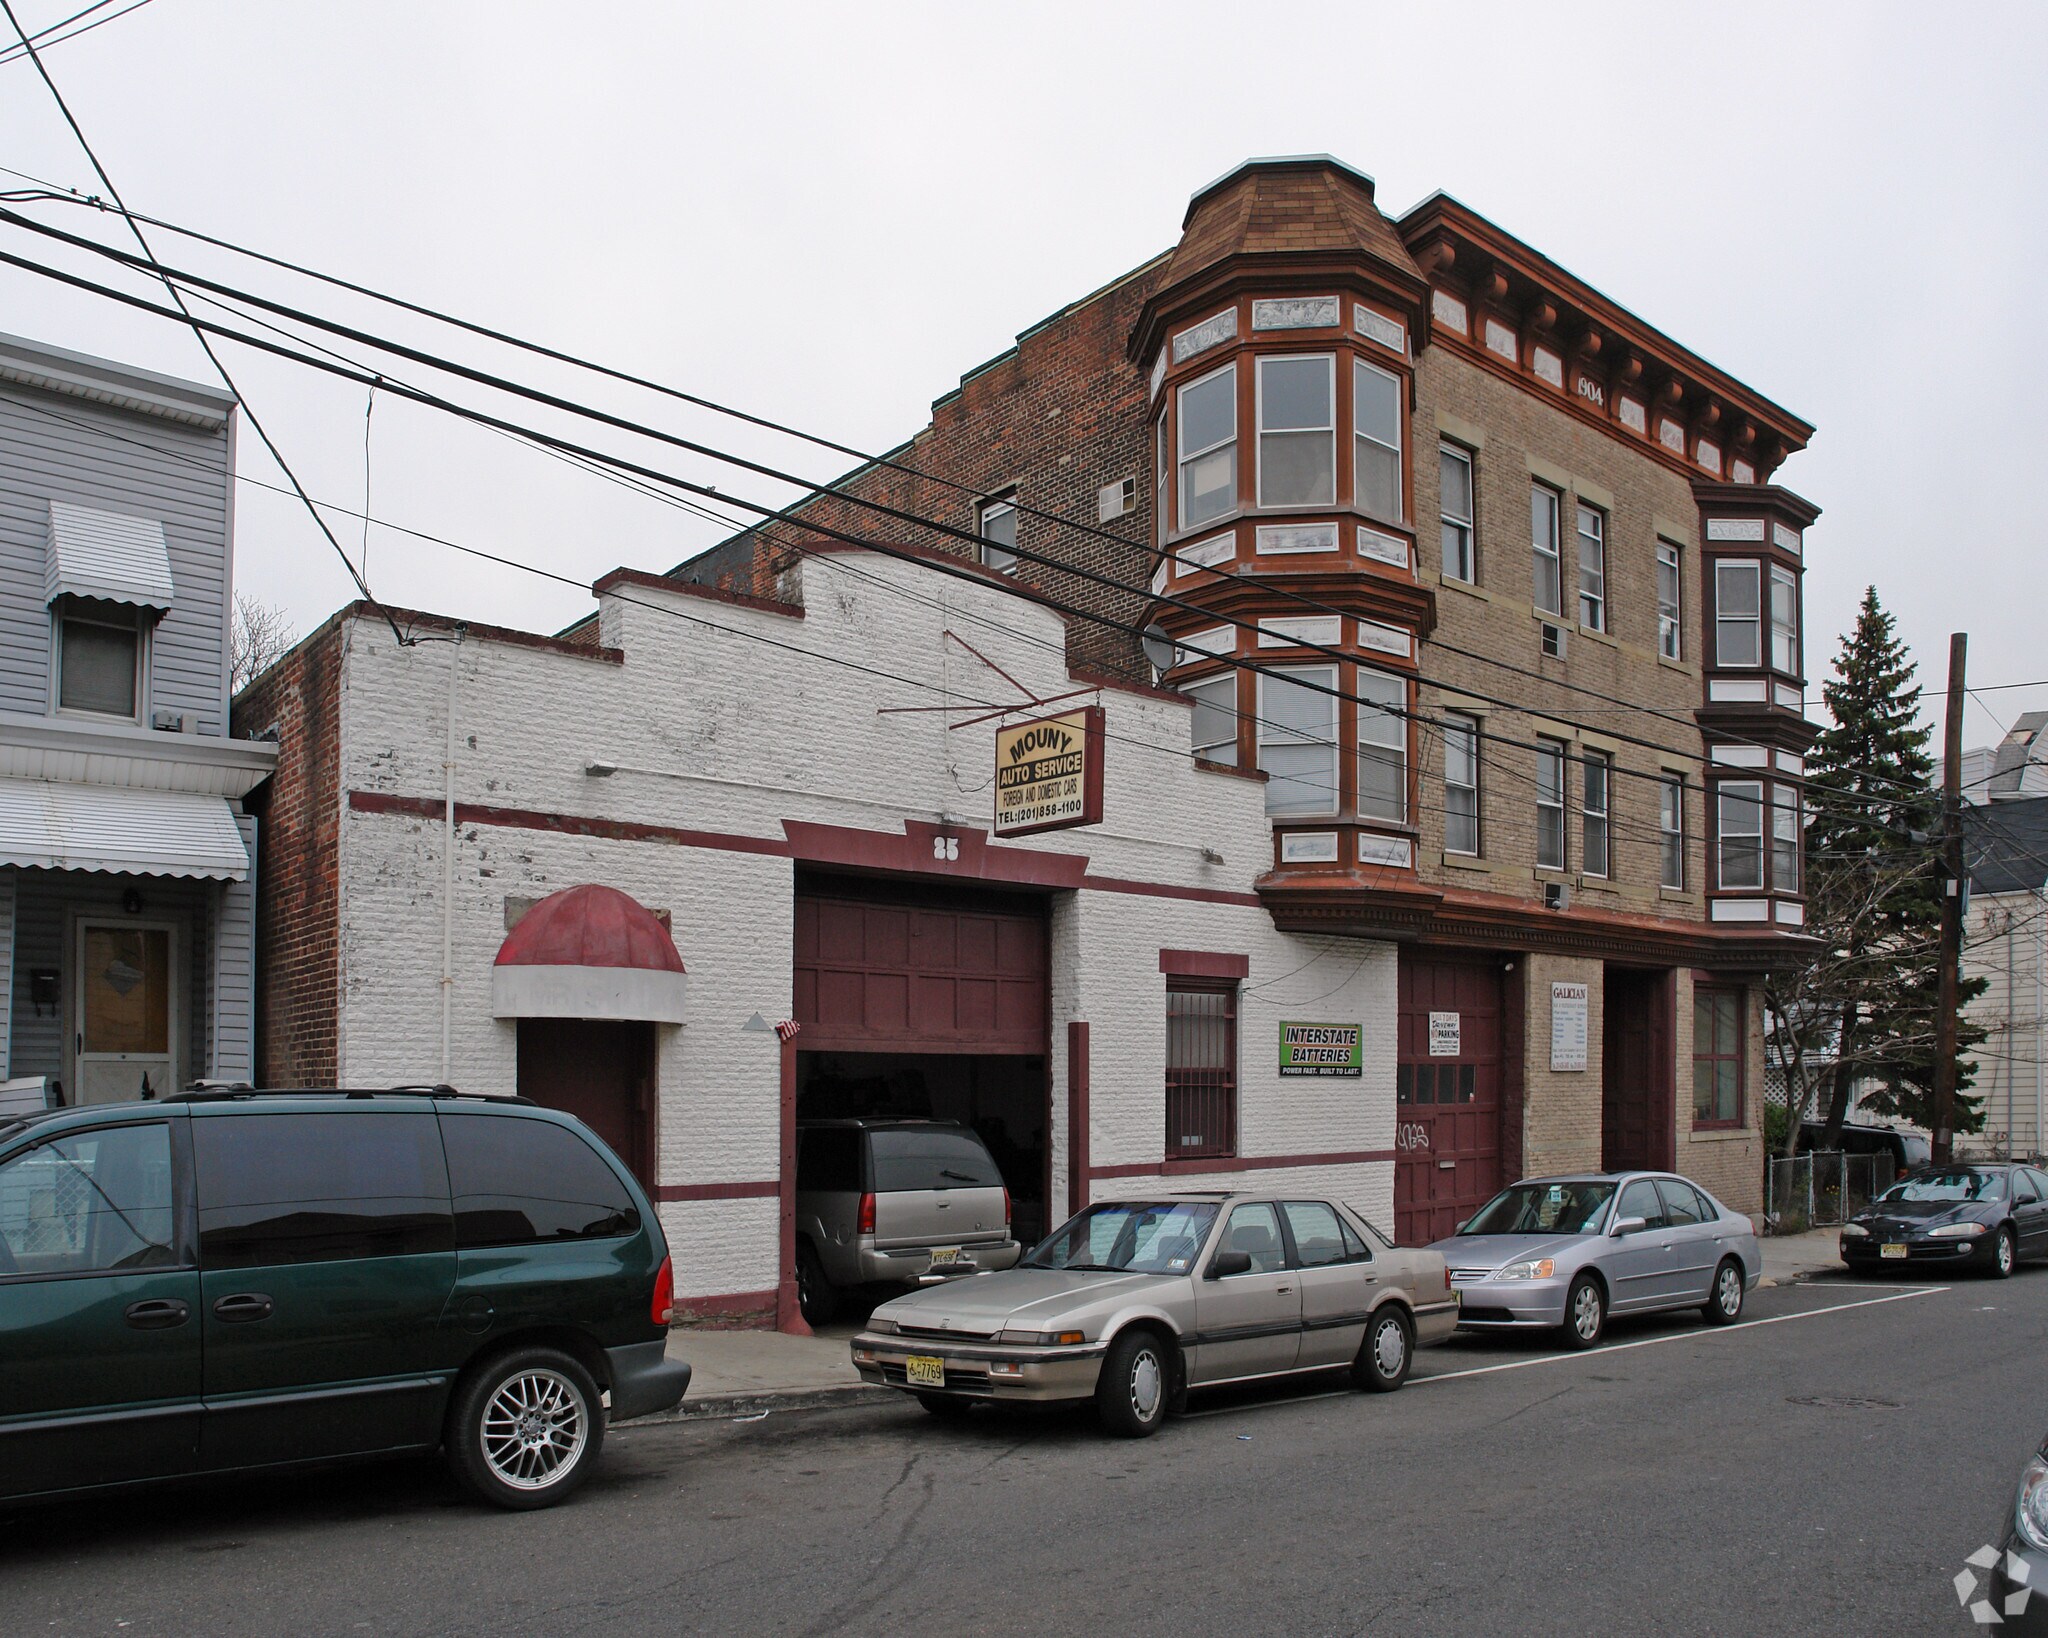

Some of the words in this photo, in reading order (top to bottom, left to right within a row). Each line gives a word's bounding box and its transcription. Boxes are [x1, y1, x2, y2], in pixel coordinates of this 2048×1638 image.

[1578, 377, 1603, 406] 1904
[1010, 728, 1072, 763] MOUNY
[1001, 765, 1030, 786] AUTO
[1035, 754, 1082, 779] SERVICE
[1003, 787, 1024, 807] FOREIGN
[1026, 786, 1036, 803] AND
[1038, 781, 1061, 800] DOMESTIC
[1064, 778, 1077, 795] CARS
[998, 799, 1081, 824] TEL:(201)858-1100
[934, 836, 959, 861] 85
[1553, 987, 1586, 999] GALICIAN
[1285, 1027, 1357, 1044] INTERSTATE
[1438, 1029, 1460, 1039] PARKING
[1291, 1048, 1350, 1062] BATTERIES
[1336, 1067, 1343, 1075] TO
